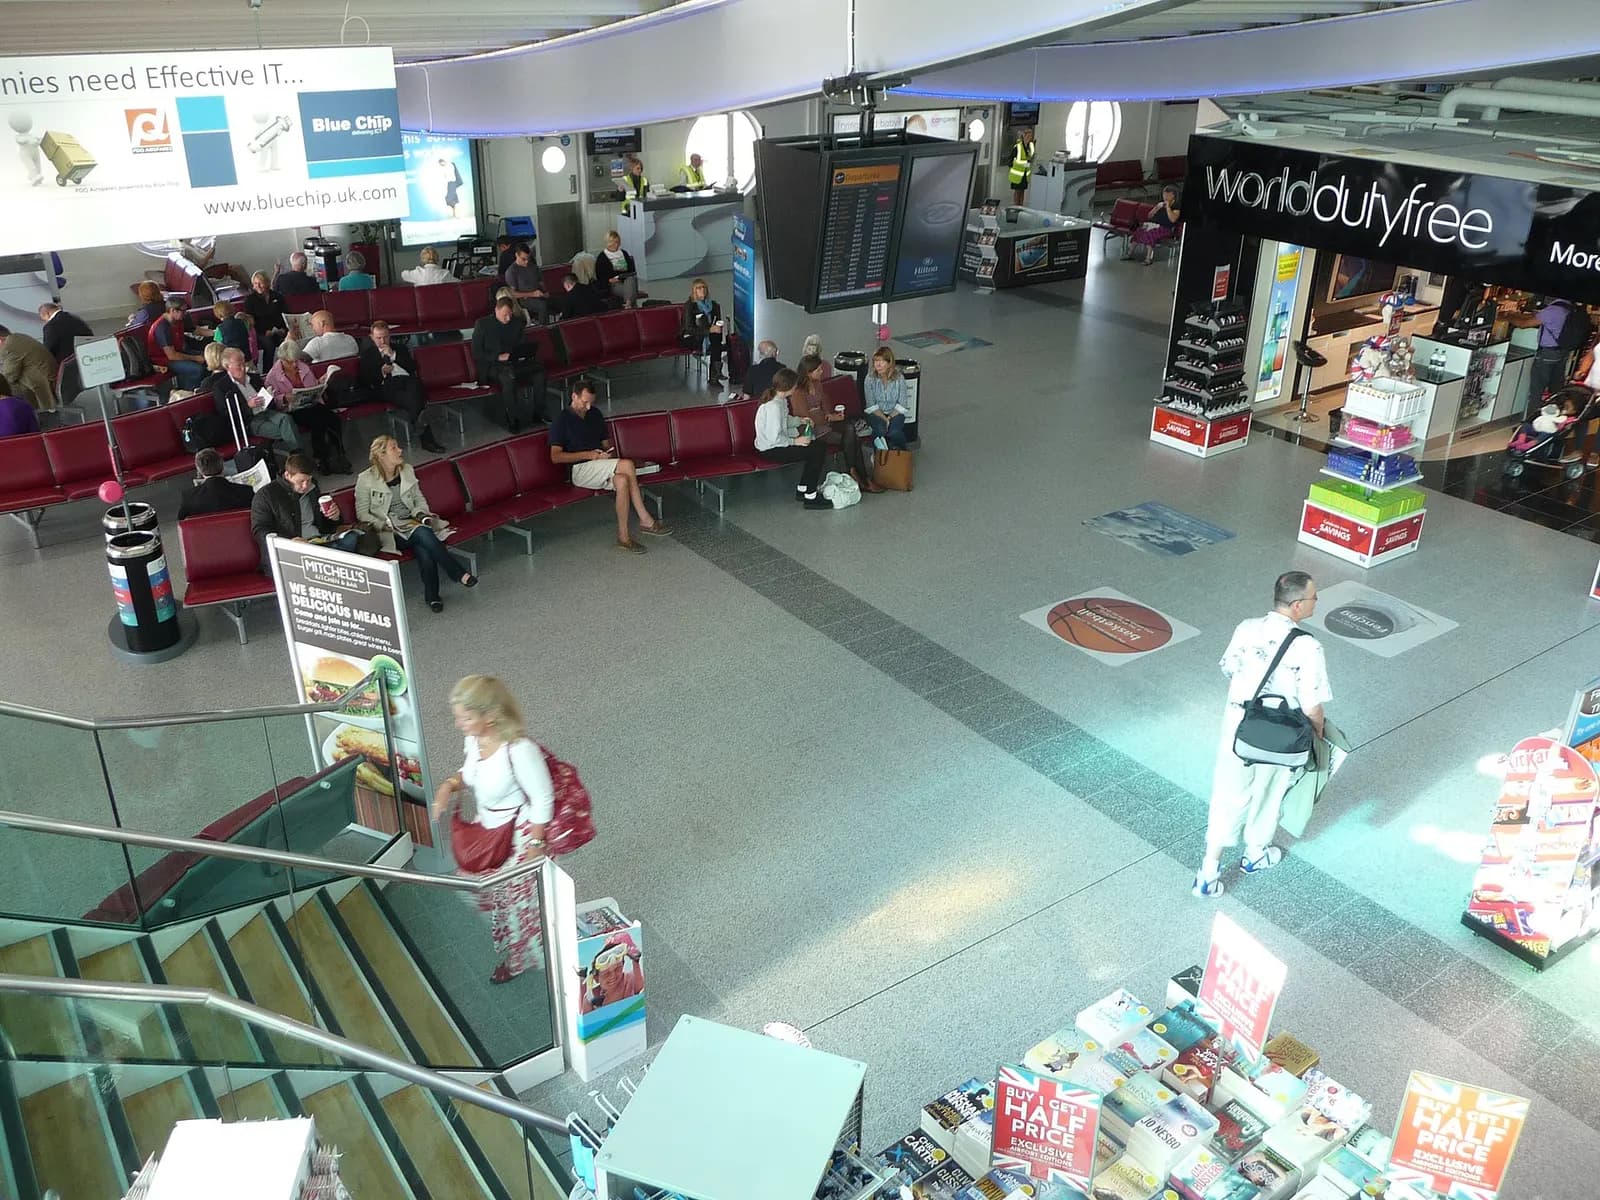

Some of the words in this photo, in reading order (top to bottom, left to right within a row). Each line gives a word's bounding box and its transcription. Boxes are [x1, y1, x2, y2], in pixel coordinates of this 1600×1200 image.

[69, 67, 136, 92] need
[146, 65, 254, 89] Effective
[263, 63, 303, 85] IT...
[312, 118, 351, 132] Blue
[355, 115, 392, 131] Chip
[204, 186, 397, 215] www.bluechip.uk.com
[1166, 423, 1191, 437] SAVINGS
[1319, 523, 1351, 542] SAVINGS
[304, 560, 365, 583] MITCHELL'S
[289, 582, 306, 594] WE
[308, 586, 343, 604] SERVE
[291, 594, 351, 618] DELICIOUS
[352, 609, 391, 628] MEALS
[294, 608, 313, 618] Come
[314, 613, 327, 621] and
[1077, 608, 1141, 641] basketball
[954, 1089, 980, 1115] MICHAE
[1006, 1086, 1034, 1102] BUY
[1049, 1099, 1077, 1113] GET
[1005, 1097, 1087, 1134] HALF
[1141, 1117, 1152, 1128] JO
[1412, 1107, 1507, 1146] HALF
[918, 1136, 938, 1155] CHRI
[1012, 1118, 1075, 1149] PRICE
[1417, 1129, 1490, 1162] PRICE
[904, 1135, 939, 1168] CARTER
[1010, 1145, 1038, 1158] AIRPORT
[1040, 1153, 1073, 1167] EDITIONS
[1011, 1136, 1074, 1160] EXCLUSIVE
[1412, 1149, 1484, 1175] EXCLUSIVE
[937, 1168, 961, 1190] CUSS
[951, 1168, 970, 1185] CLIV
[1193, 1162, 1223, 1191] BUSTERS
